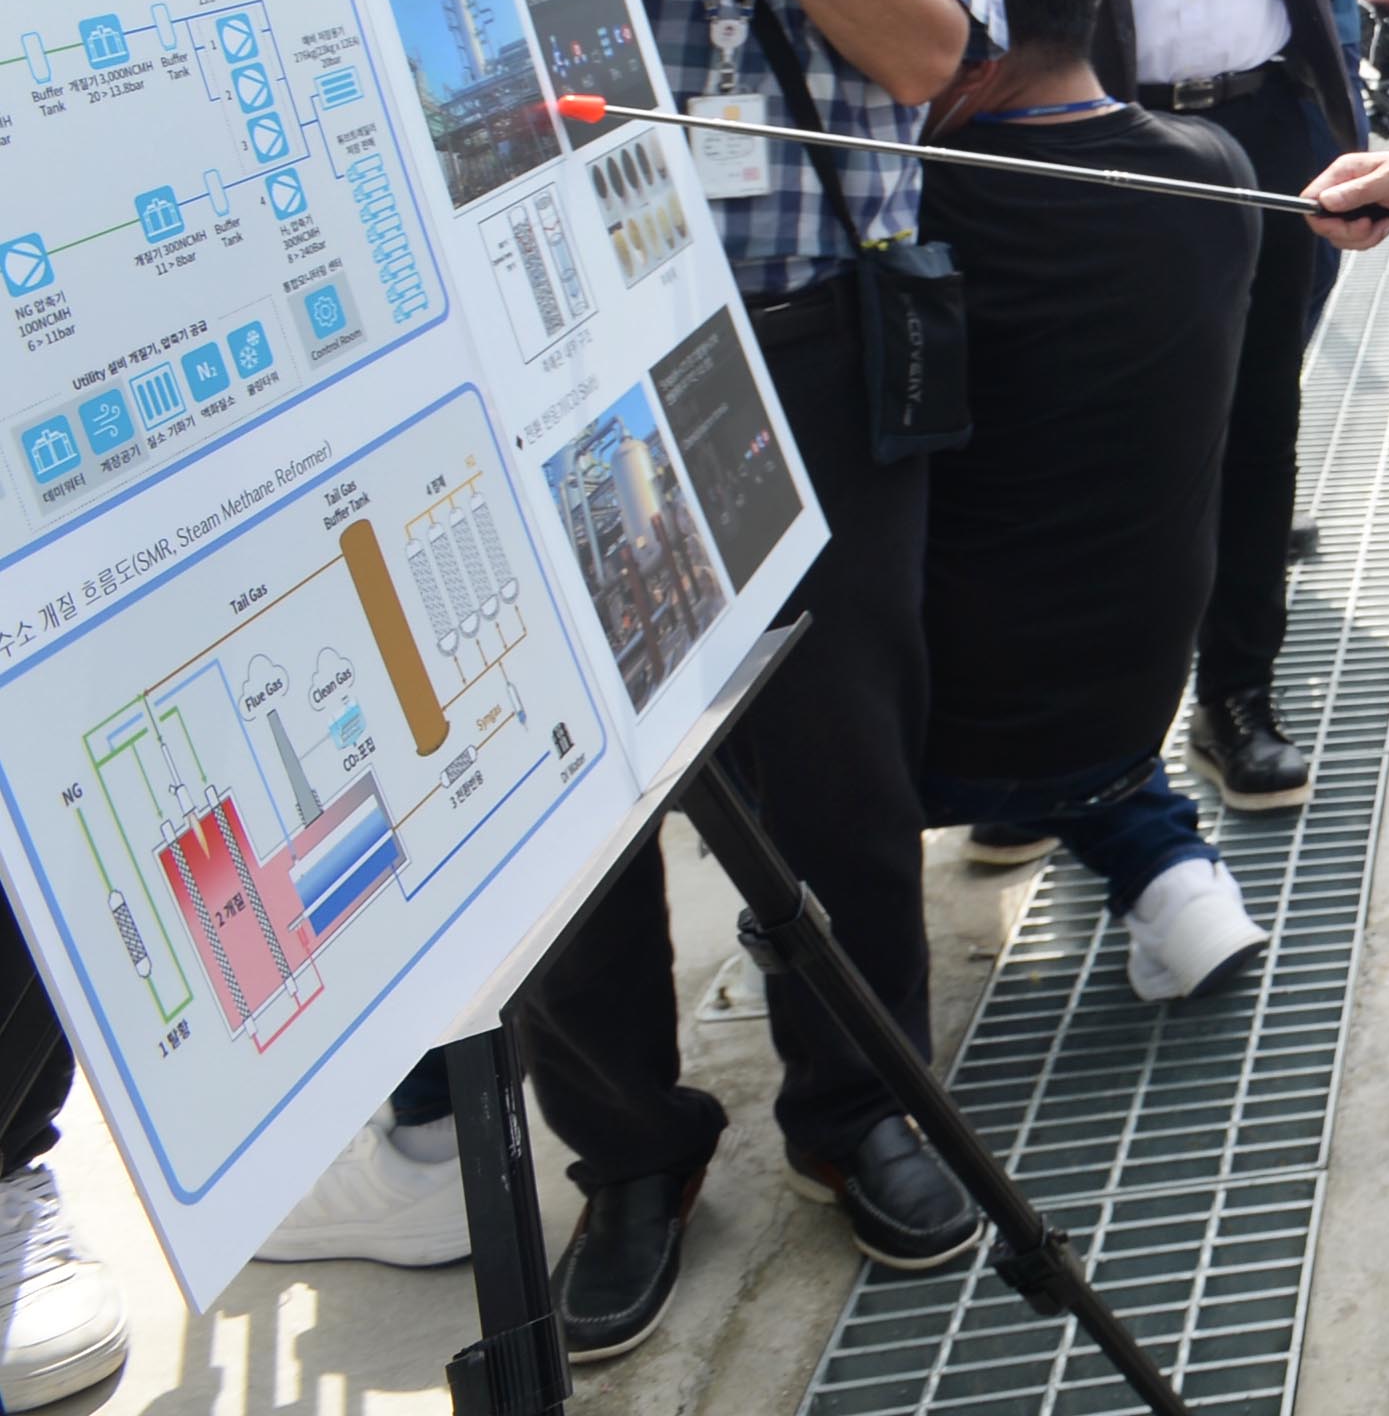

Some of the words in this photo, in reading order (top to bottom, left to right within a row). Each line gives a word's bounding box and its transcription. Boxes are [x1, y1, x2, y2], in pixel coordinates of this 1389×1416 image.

[160, 52, 189, 68] Buffer
[167, 66, 191, 81] Tank
[31, 86, 65, 103] Buffer
[39, 100, 67, 117] Tank
[214, 216, 242, 236] Buffer
[221, 232, 244, 249] Tank
[15, 304, 34, 321] NG
[33, 290, 67, 314] 압축기
[18, 307, 73, 339] 100NCMH
[45, 323, 76, 346] 11bar
[311, 339, 341, 362] Control
[340, 328, 362, 348] Room
[72, 368, 106, 391] Utility
[323, 487, 341, 508] Tail
[339, 479, 358, 498] Gas
[322, 505, 350, 532] Buffer
[348, 490, 371, 515] Tank
[37, 591, 79, 633] 개질
[175, 513, 222, 549] Steam
[220, 479, 276, 519] Methane
[274, 439, 333, 488] Reformer)
[229, 595, 250, 616] Tail
[249, 582, 268, 605] Gas
[244, 690, 266, 712] Flue
[265, 678, 284, 697] Gas
[312, 681, 338, 704] Clean
[336, 668, 352, 686] Gas
[62, 782, 83, 807] NG
[224, 892, 246, 921] 개질
[168, 1019, 192, 1051] 탈황
